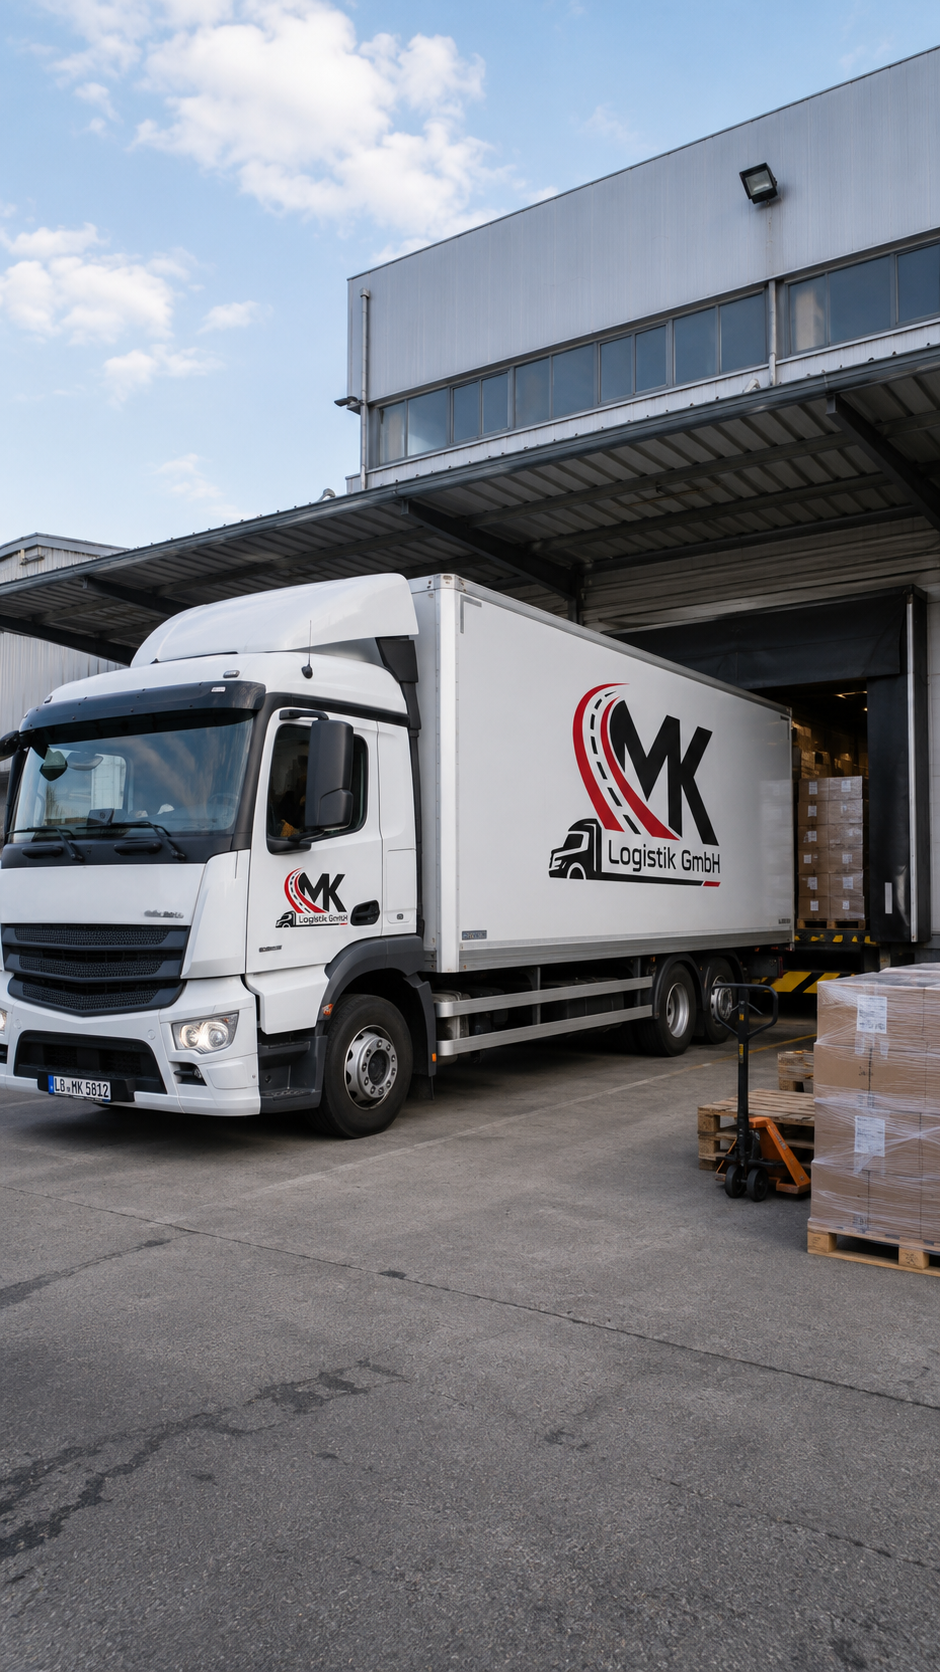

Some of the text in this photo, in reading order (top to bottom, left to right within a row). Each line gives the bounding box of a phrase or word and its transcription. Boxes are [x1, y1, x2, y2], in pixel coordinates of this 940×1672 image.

[609, 700, 719, 846] MK
[609, 839, 720, 873] Logistik GmbH
[298, 872, 347, 912] MK
[54, 1077, 65, 1092] LB
[85, 1082, 109, 1098] 5812
